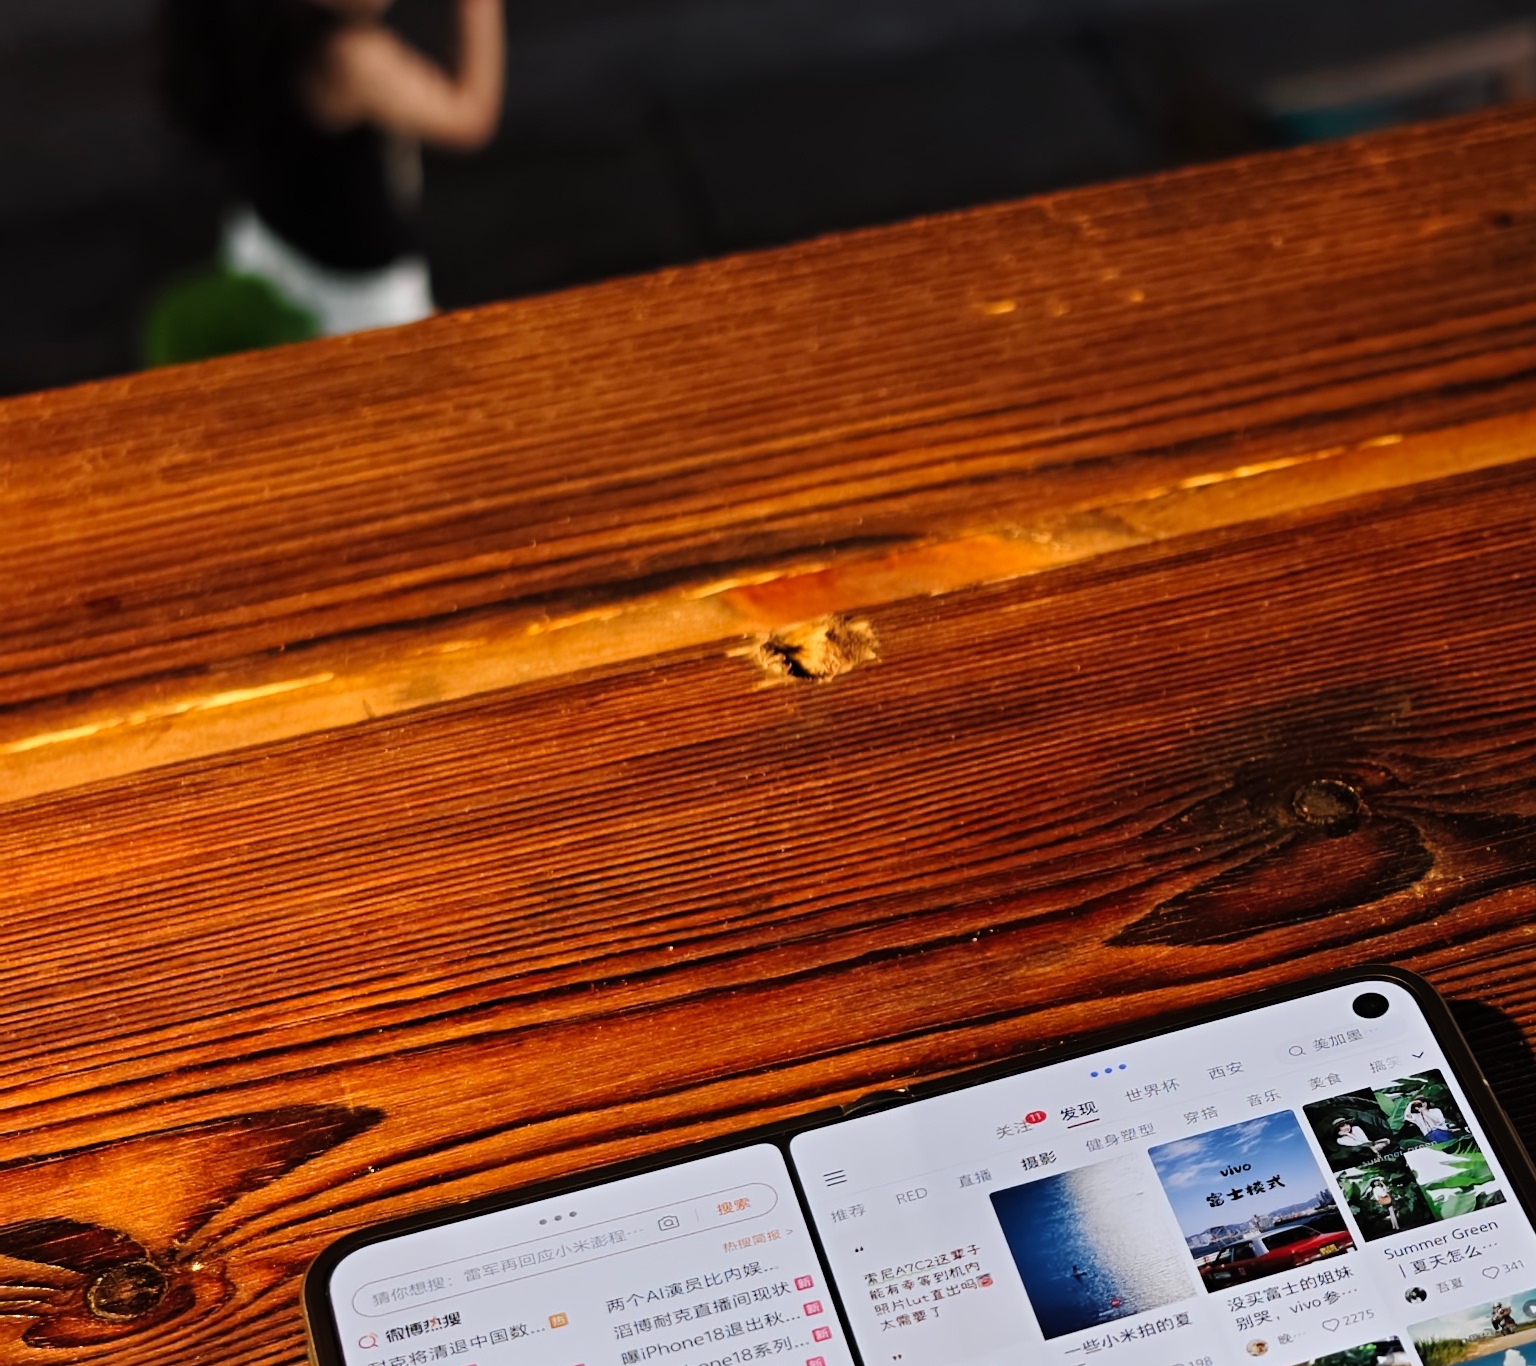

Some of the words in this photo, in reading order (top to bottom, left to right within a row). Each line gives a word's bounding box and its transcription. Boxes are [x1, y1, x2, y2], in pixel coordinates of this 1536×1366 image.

[1207, 1061, 1244, 1080] 西安
[1124, 1078, 1180, 1102] 世界杯
[1308, 1073, 1342, 1090] 美食
[1246, 1089, 1281, 1107] 音乐
[1060, 1101, 1098, 1121] 发现
[1183, 1106, 1218, 1125] 穿搭
[993, 1117, 1035, 1140] 关注
[1027, 1111, 1043, 1123] 11
[1085, 1123, 1156, 1152] 健身塑型
[1021, 1151, 1056, 1171] 摄影
[1217, 1158, 1254, 1179] vivo
[957, 1169, 992, 1188] 直播
[896, 1187, 927, 1205] RED
[1202, 1173, 1288, 1209] 富士模式
[717, 1197, 751, 1216] 搜索
[831, 1204, 866, 1223] 推荐
[722, 1229, 781, 1253] 热搜简报
[1384, 1234, 1448, 1260] Summer
[1451, 1219, 1498, 1239] Green
[1502, 1260, 1524, 1274] 341
[1226, 1266, 1354, 1312] 没买富士的姐妹
[880, 1306, 940, 1331] 太需要了
[1343, 1309, 1374, 1325] 2275
[386, 1312, 461, 1343] 微博热搜
[1063, 1312, 1192, 1358] 一些小米拍的夏
